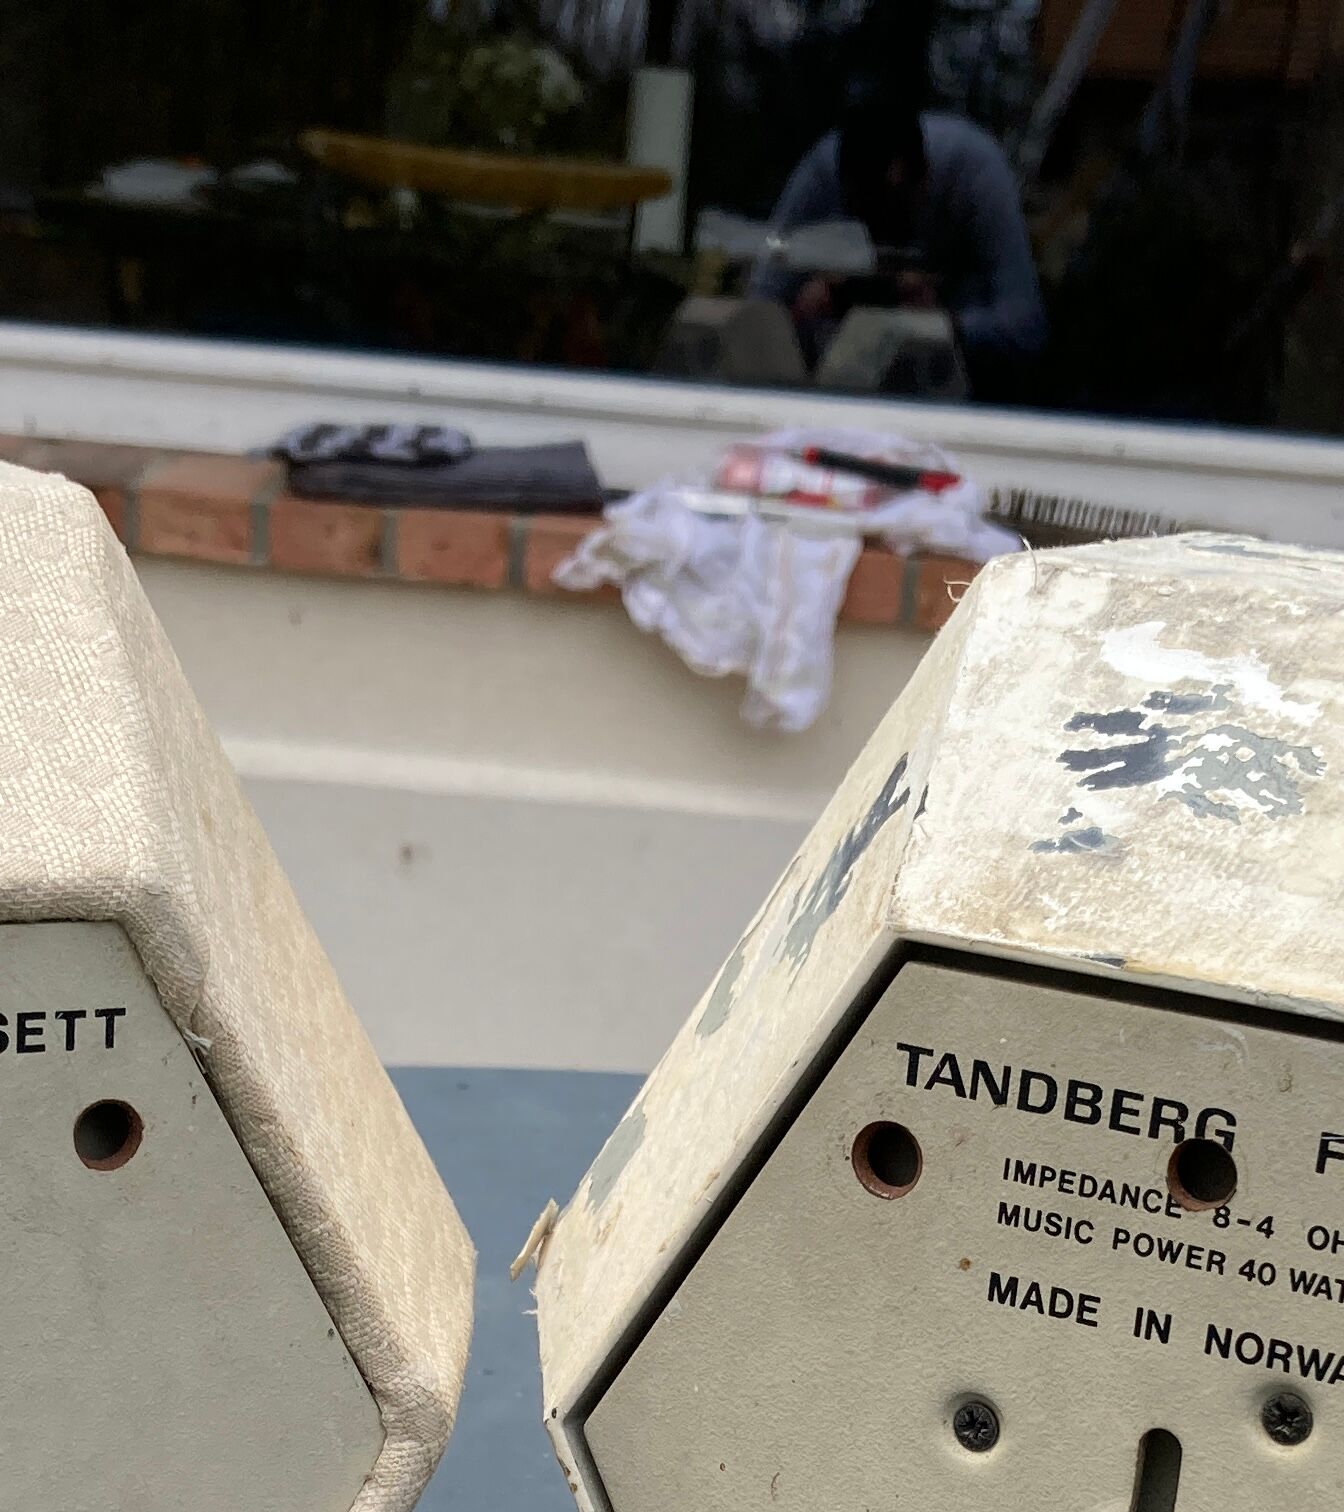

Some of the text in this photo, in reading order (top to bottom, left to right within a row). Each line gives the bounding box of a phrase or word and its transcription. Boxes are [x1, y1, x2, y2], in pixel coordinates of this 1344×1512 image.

[896, 1042, 1238, 1153] TANDBERG
[1001, 1157, 1183, 1219] IMPEDANCE
[1212, 1205, 1275, 1239] 8-4
[996, 1201, 1095, 1246] MUSIC
[1111, 1228, 1227, 1276] POWER
[1238, 1258, 1278, 1287] 40
[986, 1273, 1102, 1327] MADE
[1133, 1308, 1173, 1343] IN
